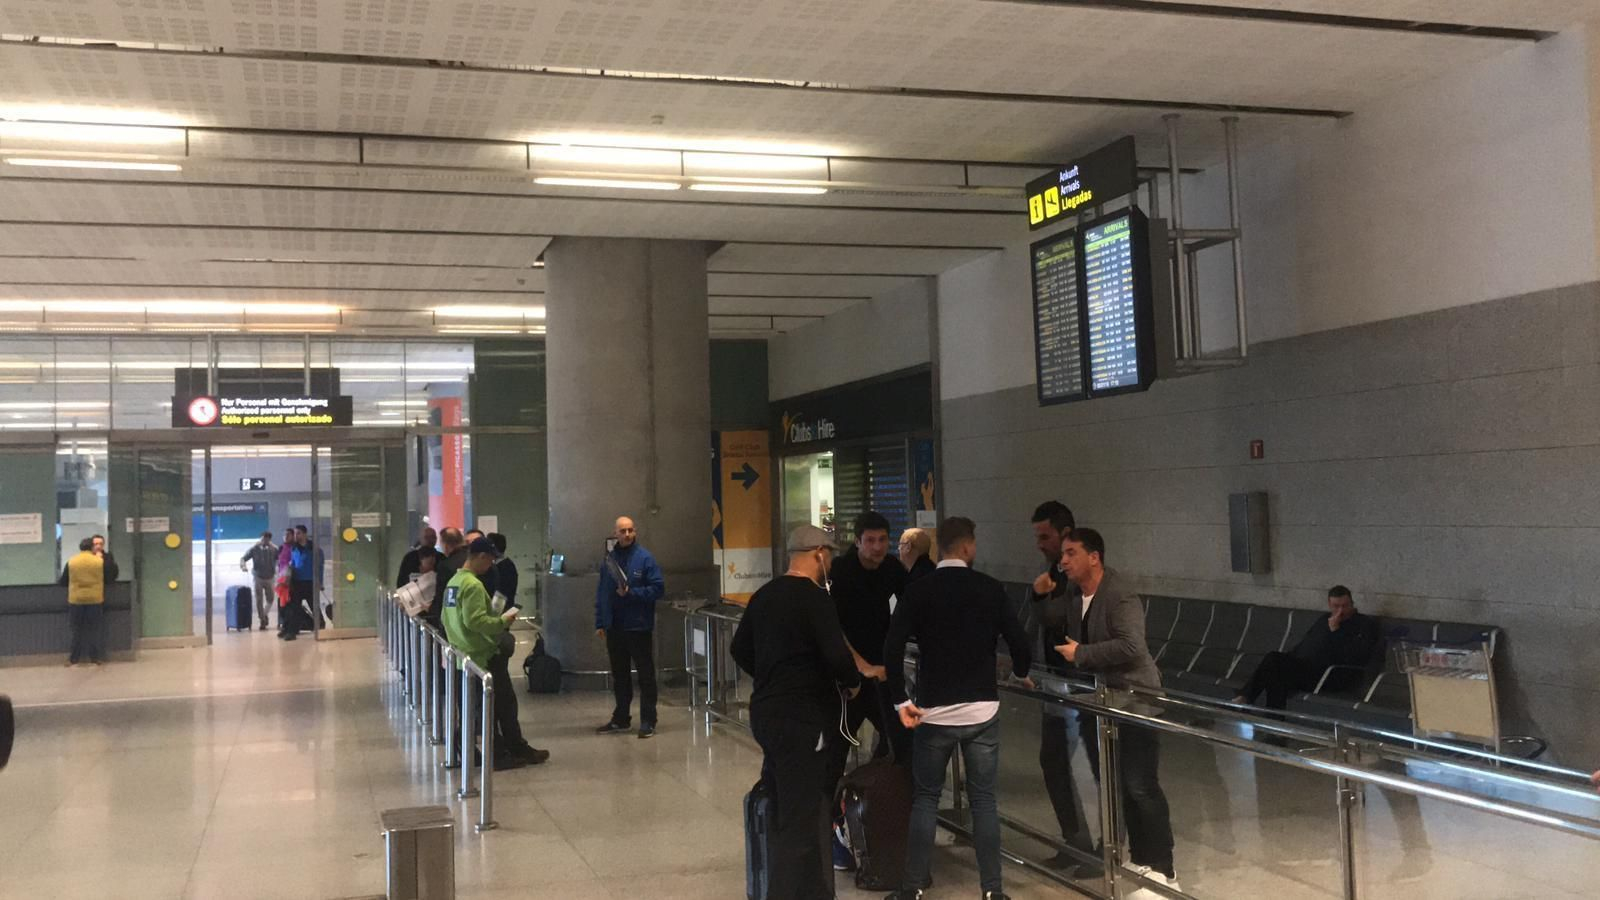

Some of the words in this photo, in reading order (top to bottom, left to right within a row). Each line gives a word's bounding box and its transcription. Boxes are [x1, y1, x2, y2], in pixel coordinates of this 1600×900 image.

[1061, 180, 1080, 195] Arrivals
[1061, 190, 1092, 210] Llegadas
[1103, 219, 1129, 235] ARRIVALS
[236, 398, 267, 406] Personal
[268, 398, 280, 406] mit
[296, 407, 311, 416] only
[221, 415, 242, 424] Sólo
[243, 415, 283, 425] personal
[285, 414, 332, 423] autorizado
[817, 418, 834, 440] Hire
[211, 504, 253, 512] ansportation
